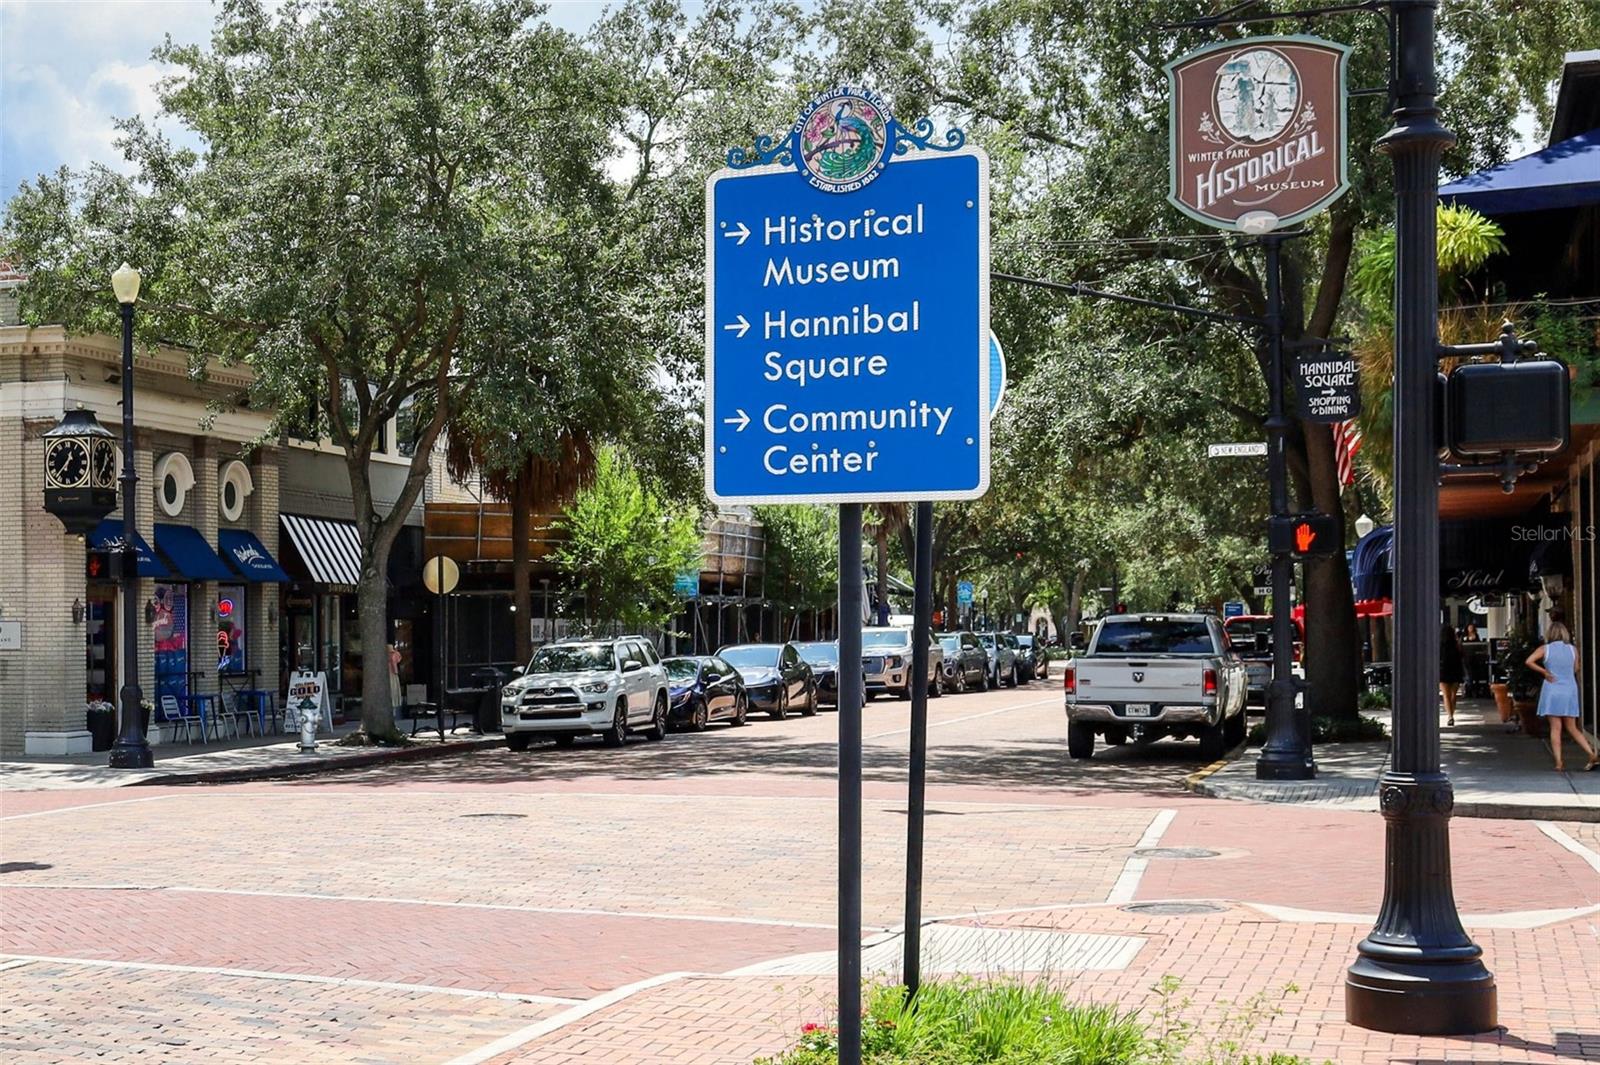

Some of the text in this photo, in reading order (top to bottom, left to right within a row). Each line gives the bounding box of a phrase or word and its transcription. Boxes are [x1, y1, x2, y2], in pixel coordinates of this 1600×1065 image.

[794, 114, 806, 133] CITY
[804, 103, 815, 115] OF
[815, 87, 844, 105] WINTER
[867, 91, 892, 123] FLORIDA
[1188, 148, 1251, 163] WINTER PARK
[809, 170, 879, 192] ESTABLISHED 1882
[1255, 179, 1325, 192] MUSEUM
[764, 203, 924, 246] Historical
[763, 256, 900, 287] Museum
[764, 300, 920, 340] Hannibal
[763, 351, 888, 387] Square
[1300, 360, 1360, 375] HANNIBAL
[1305, 373, 1354, 388] SQUARE
[1308, 395, 1351, 407] SHOPPING
[763, 400, 953, 435] Community
[763, 445, 879, 475] Center
[1448, 569, 1504, 588] Hotel
[290, 686, 320, 696] GOLD
